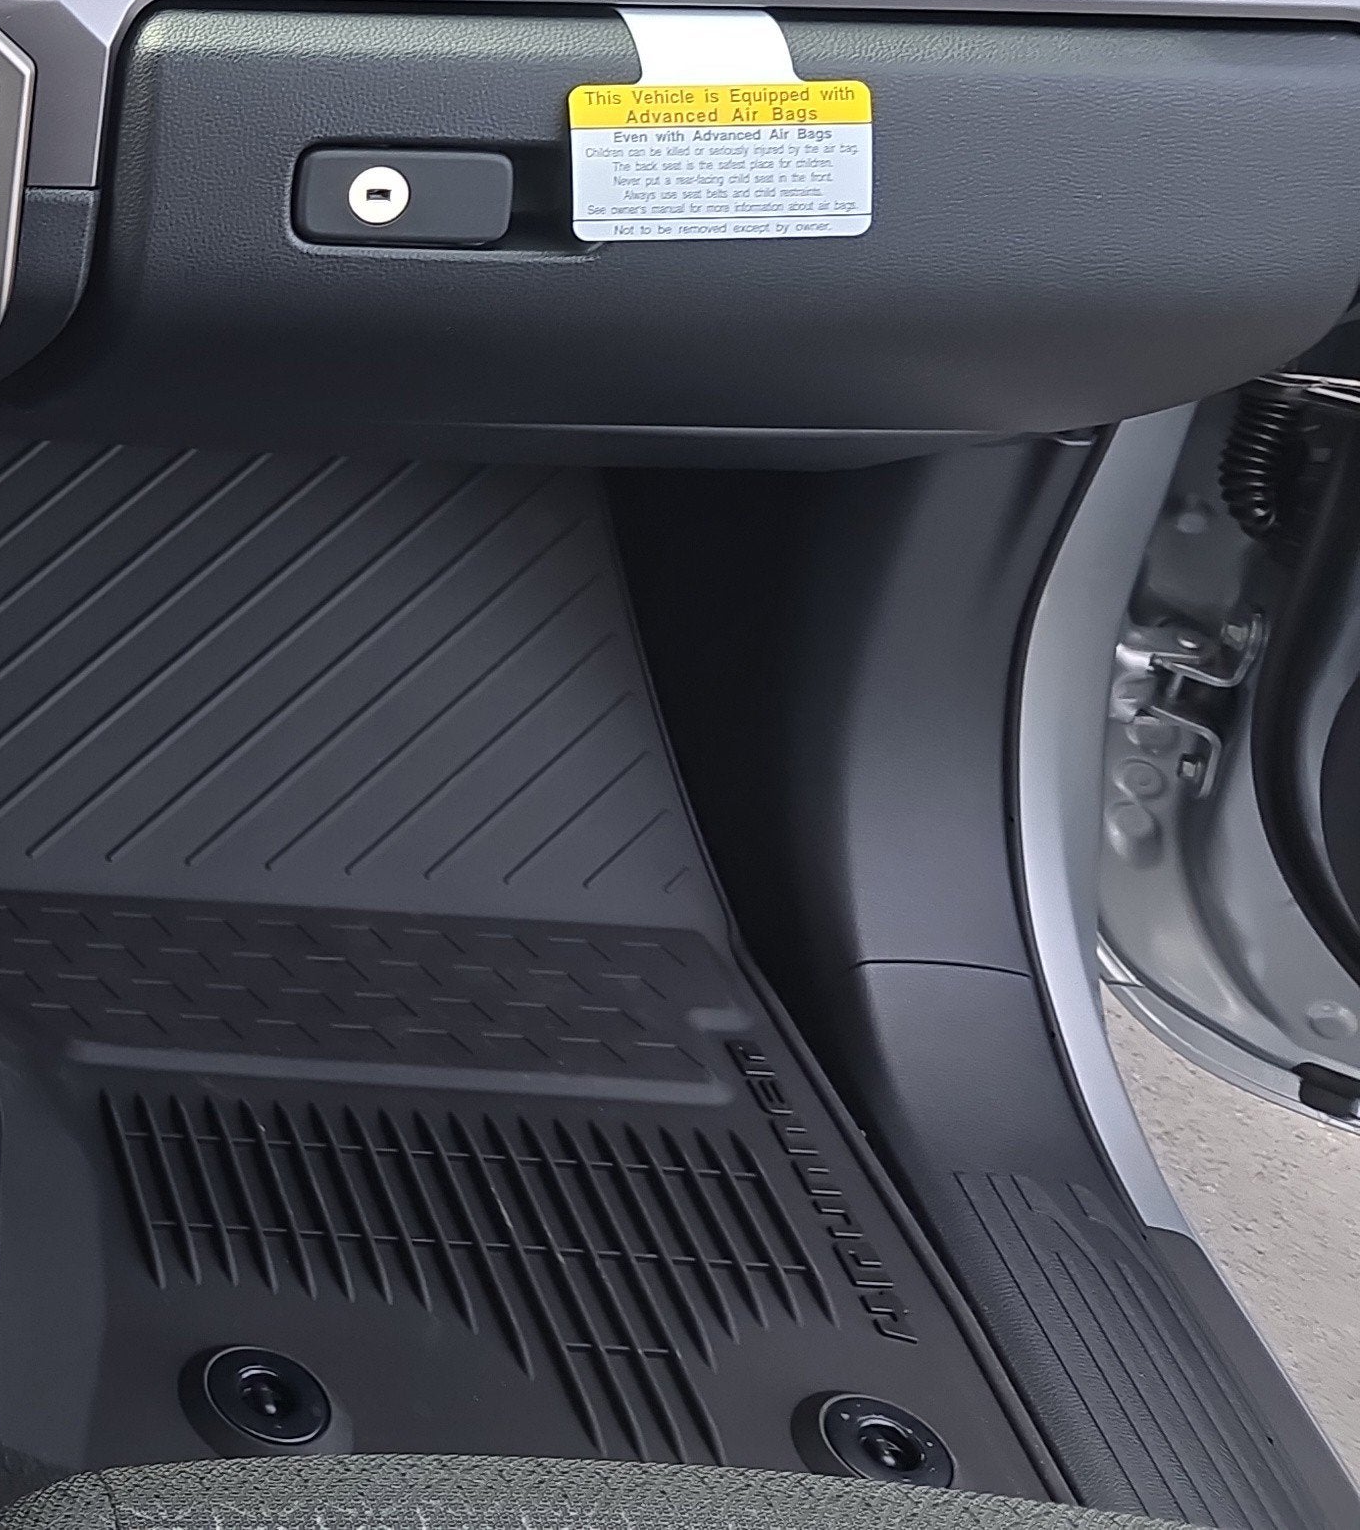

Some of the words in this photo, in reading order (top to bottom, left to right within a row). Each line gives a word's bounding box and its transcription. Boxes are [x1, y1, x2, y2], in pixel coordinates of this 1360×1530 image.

[584, 90, 622, 105] This
[632, 89, 695, 104] Vehicle
[705, 88, 720, 103] is
[730, 87, 810, 106] Equipped
[820, 86, 856, 101] with
[626, 108, 718, 124] Advanced
[731, 107, 758, 122] Air
[772, 106, 818, 122] Bags
[613, 131, 648, 143] Even
[656, 130, 685, 142] with
[692, 129, 761, 142] Advanced
[769, 128, 790, 140] Air
[797, 128, 833, 142] Bags
[585, 147, 624, 157] Children
[628, 149, 646, 157] can
[650, 147, 661, 156] be
[667, 146, 690, 156] killed
[694, 148, 706, 156] or
[710, 145, 749, 157] seriously
[753, 144, 785, 157] injured
[788, 144, 800, 157] by
[804, 144, 820, 154] the
[823, 143, 836, 154] air
[612, 161, 631, 171] The
[635, 161, 658, 171] back
[662, 161, 682, 171] seat
[687, 160, 694, 170] is
[699, 160, 713, 170] the
[719, 159, 746, 170] safest
[750, 159, 774, 171] place
[779, 158, 792, 169] for
[613, 175, 641, 186] Never
[645, 176, 660, 187] put
[676, 174, 724, 187] rear-facing
[728, 173, 751, 184] child
[754, 174, 774, 183] seat
[778, 173, 788, 183] in
[791, 173, 806, 183] the
[623, 190, 656, 202] Always
[661, 191, 678, 200] use
[682, 190, 702, 199] seat
[706, 189, 728, 199] belts
[732, 188, 750, 198] and
[754, 188, 776, 198] child
[587, 204, 607, 215] See
[651, 203, 686, 214] manual
[690, 203, 702, 213] for
[707, 204, 730, 213] more
[734, 201, 784, 213] information
[788, 201, 814, 211] about
[613, 224, 635, 236] Not
[640, 225, 652, 235] to
[658, 224, 672, 235] be
[678, 223, 727, 235] removed
[733, 222, 771, 235] except
[776, 222, 790, 235] by
